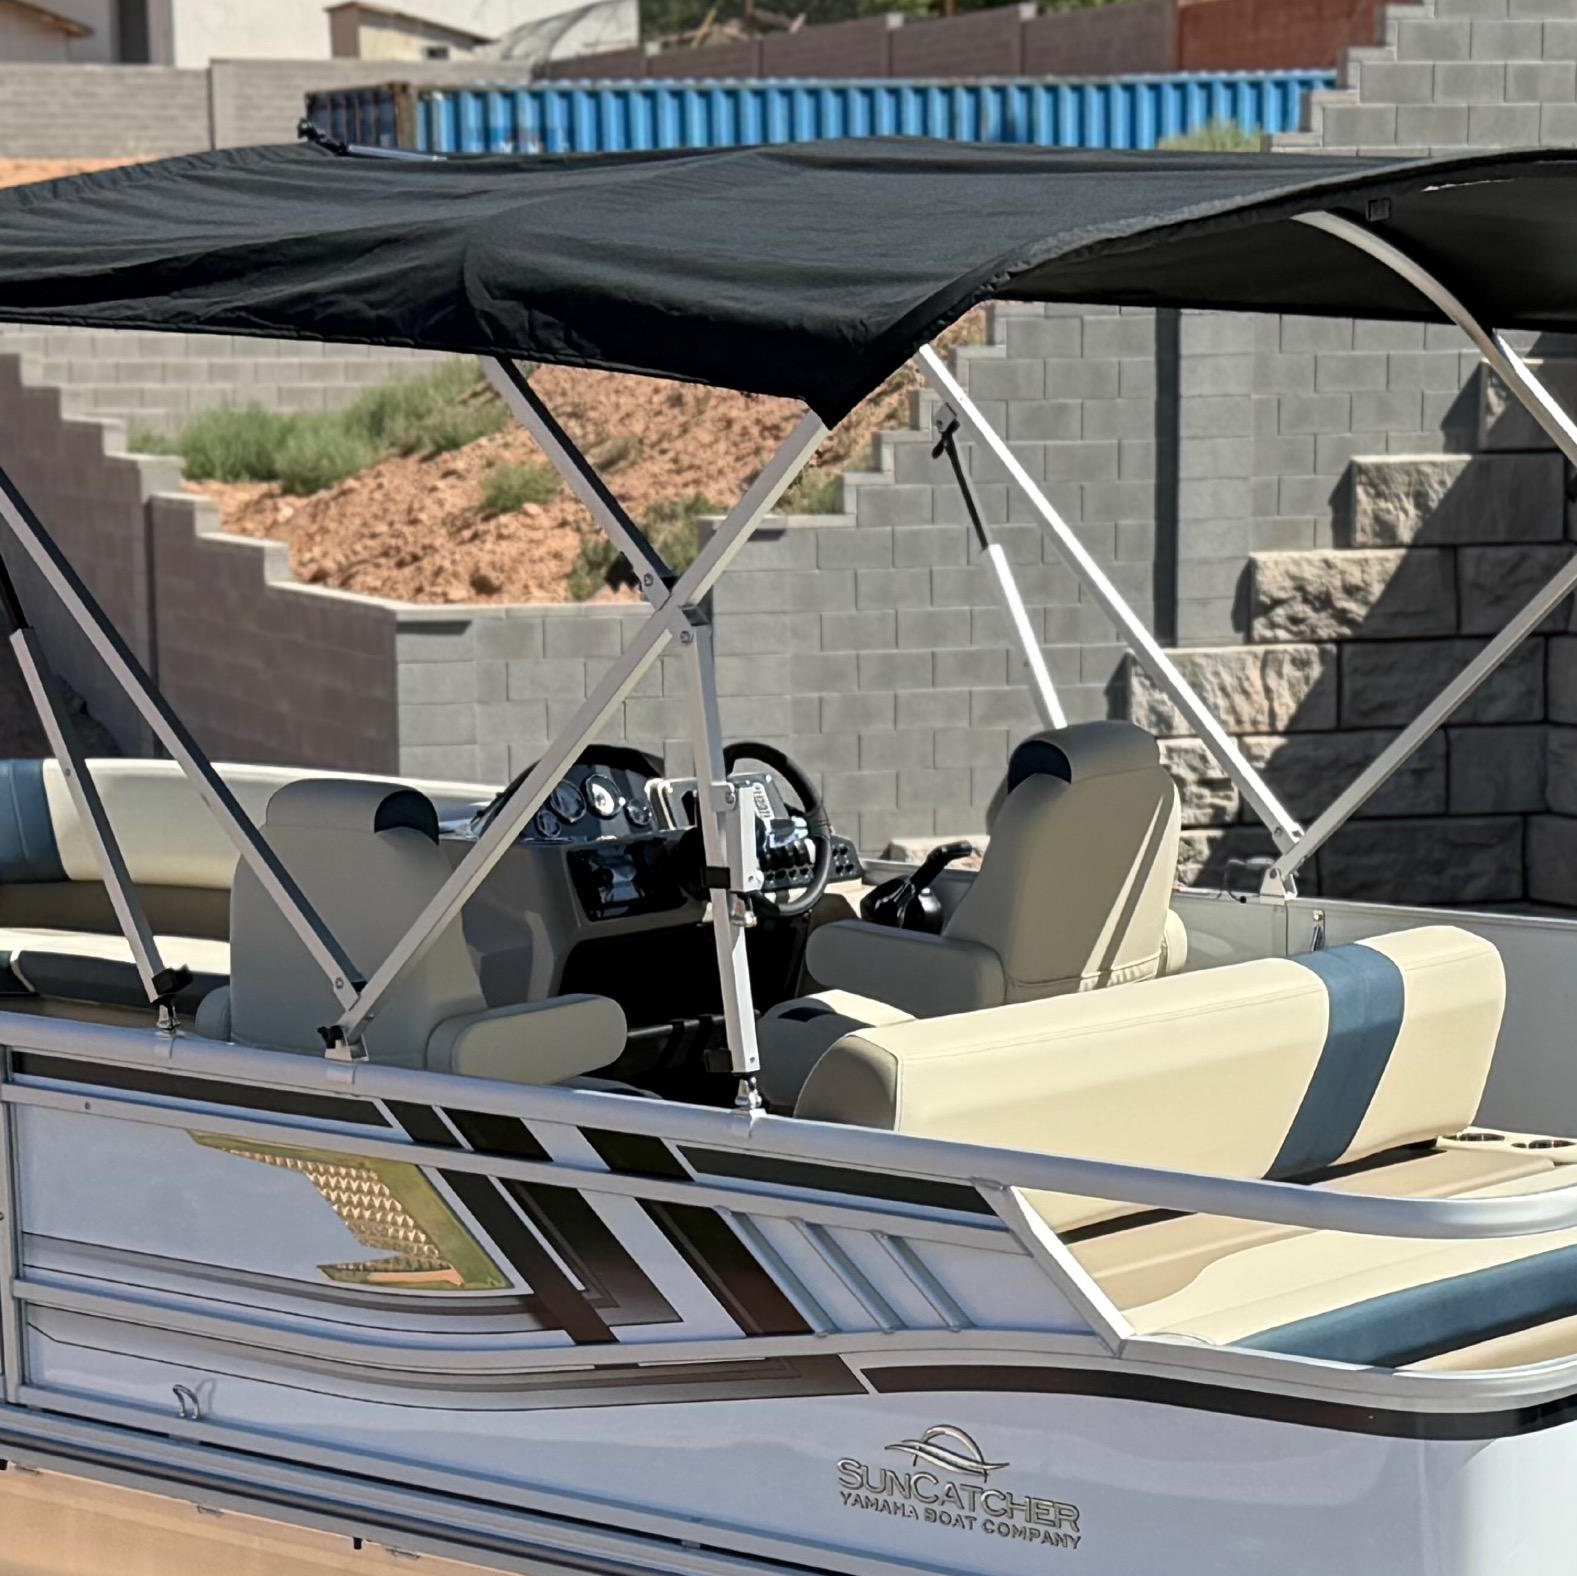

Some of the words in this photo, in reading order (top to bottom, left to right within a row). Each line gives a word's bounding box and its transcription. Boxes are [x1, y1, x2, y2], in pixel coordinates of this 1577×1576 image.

[837, 1458, 1080, 1532] SUNCATCHER
[840, 1490, 919, 1520] YAMAHA
[923, 1507, 977, 1531] BOAT
[982, 1518, 1081, 1550] COMPANY
